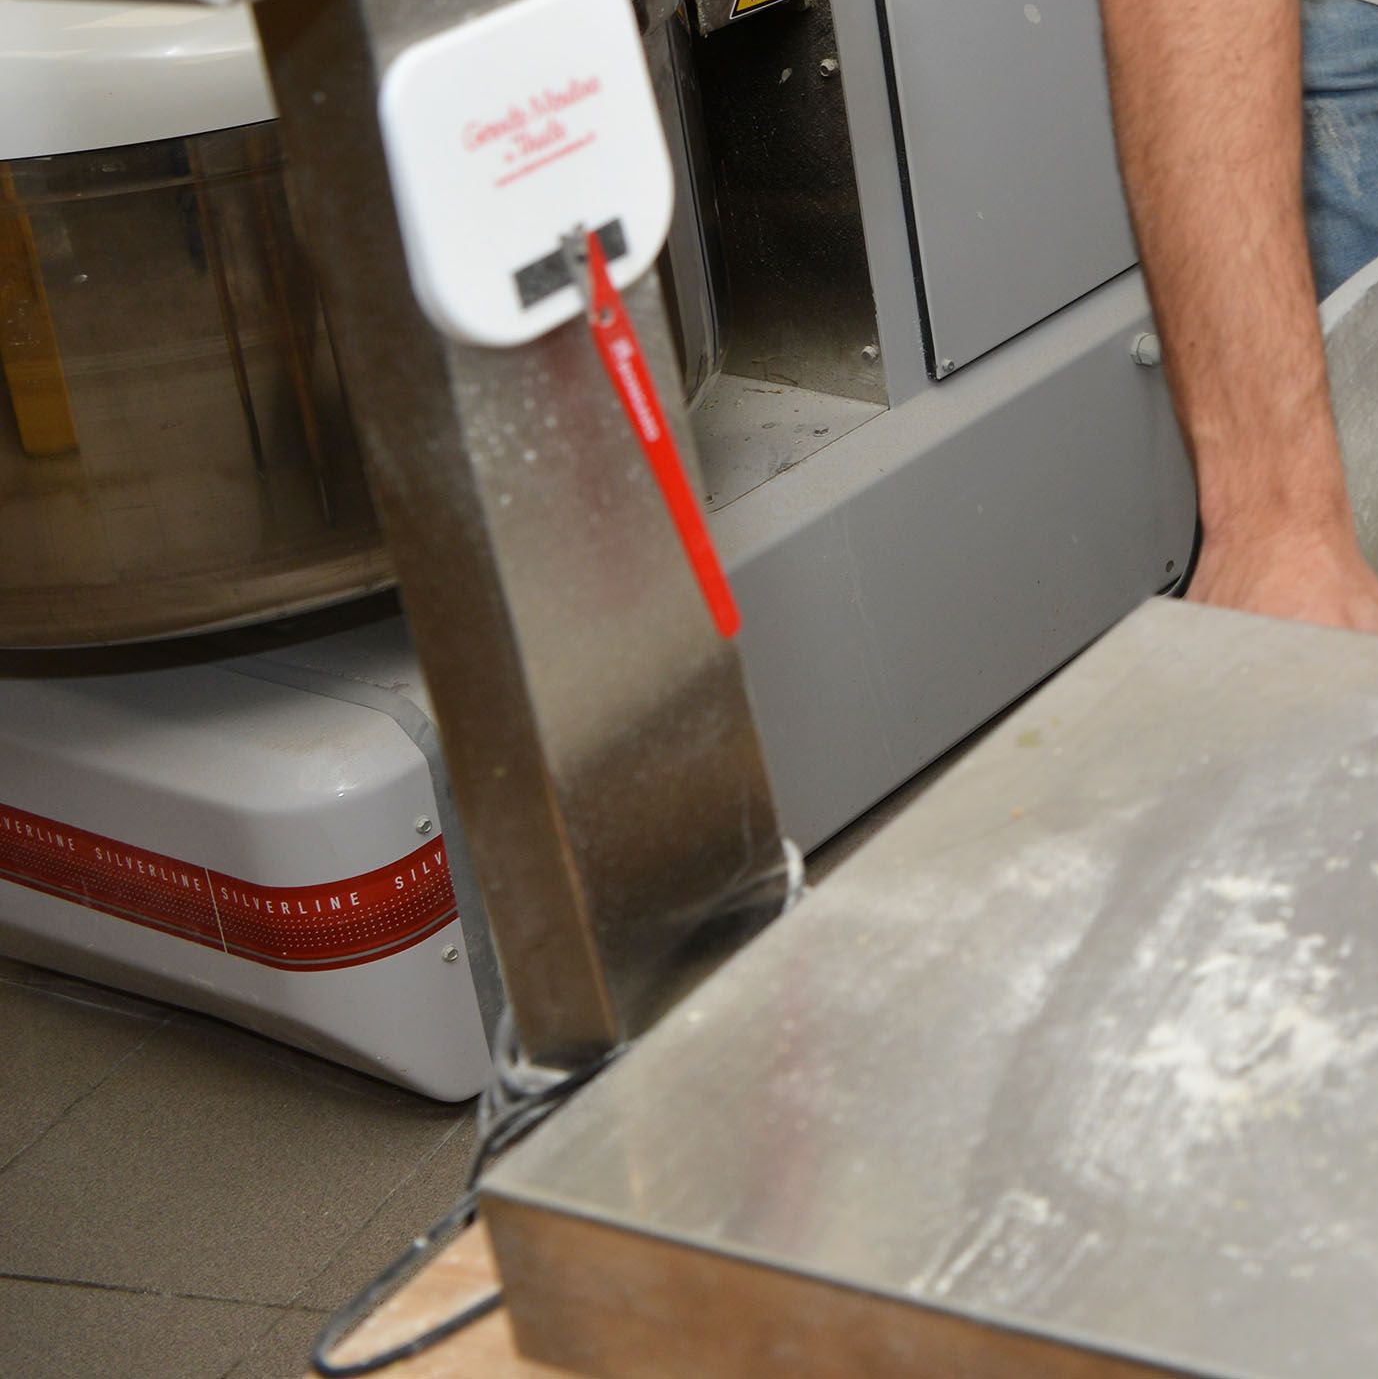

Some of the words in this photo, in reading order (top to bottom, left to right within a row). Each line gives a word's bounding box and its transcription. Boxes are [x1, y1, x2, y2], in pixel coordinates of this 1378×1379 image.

[0, 817, 75, 851] VERLINE
[95, 847, 201, 891] SILVERLINE
[221, 887, 360, 915] SILVERLINE
